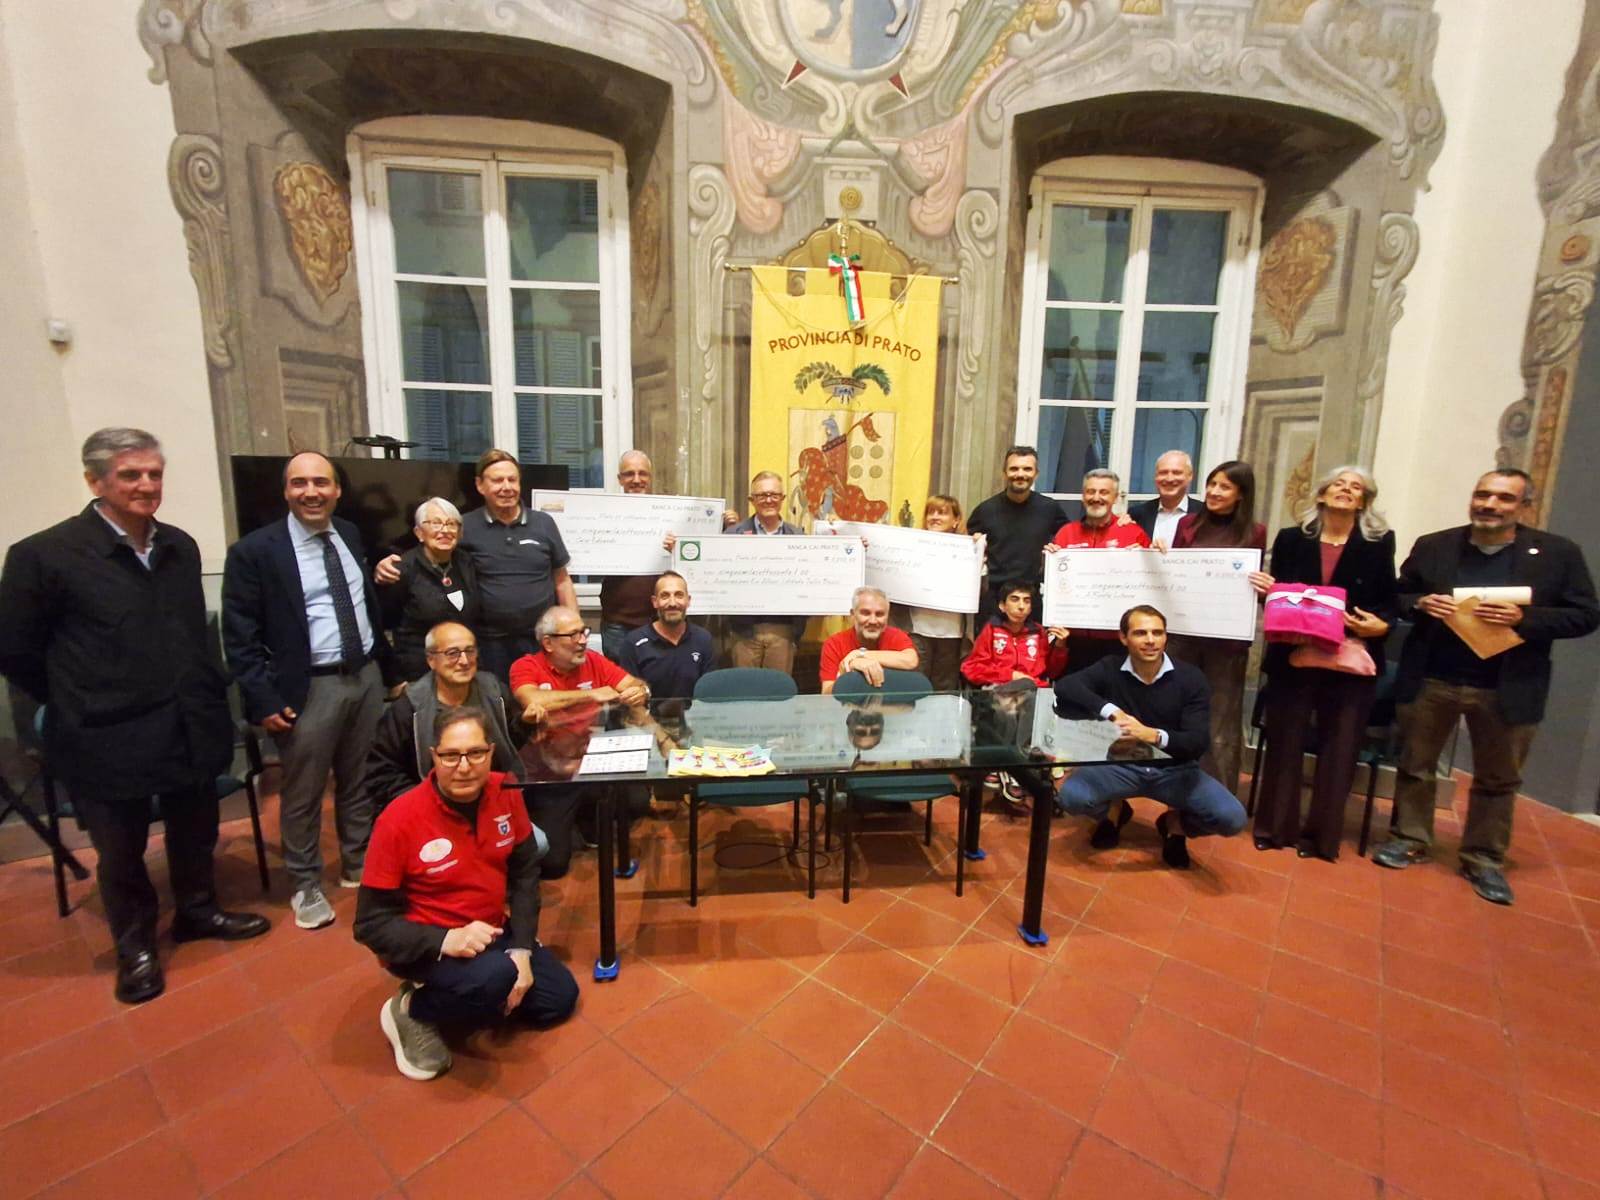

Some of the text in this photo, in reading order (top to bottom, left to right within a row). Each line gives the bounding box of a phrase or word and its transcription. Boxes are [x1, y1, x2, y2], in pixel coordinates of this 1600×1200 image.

[768, 330, 922, 362] PROVINCIA DI PRATO
